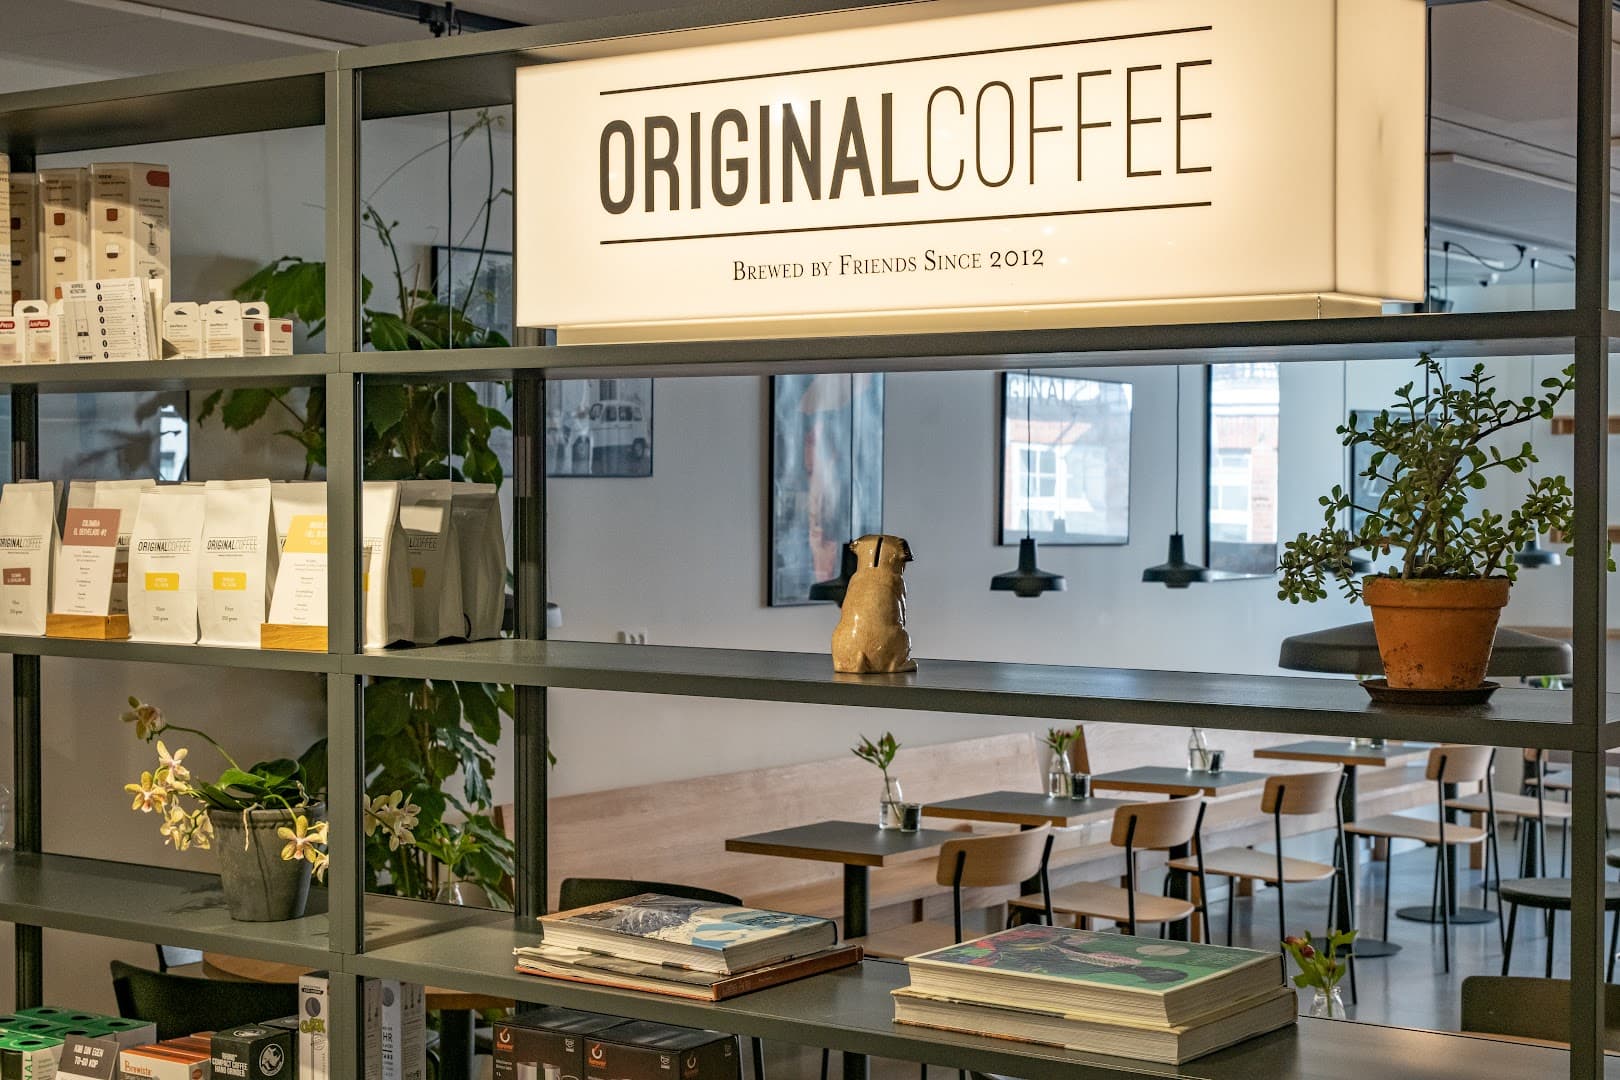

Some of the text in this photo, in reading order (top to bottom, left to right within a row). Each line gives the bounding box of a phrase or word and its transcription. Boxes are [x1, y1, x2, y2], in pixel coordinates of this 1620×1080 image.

[732, 248, 1044, 281] BREWED BY FRIENDS SINCE 2012
